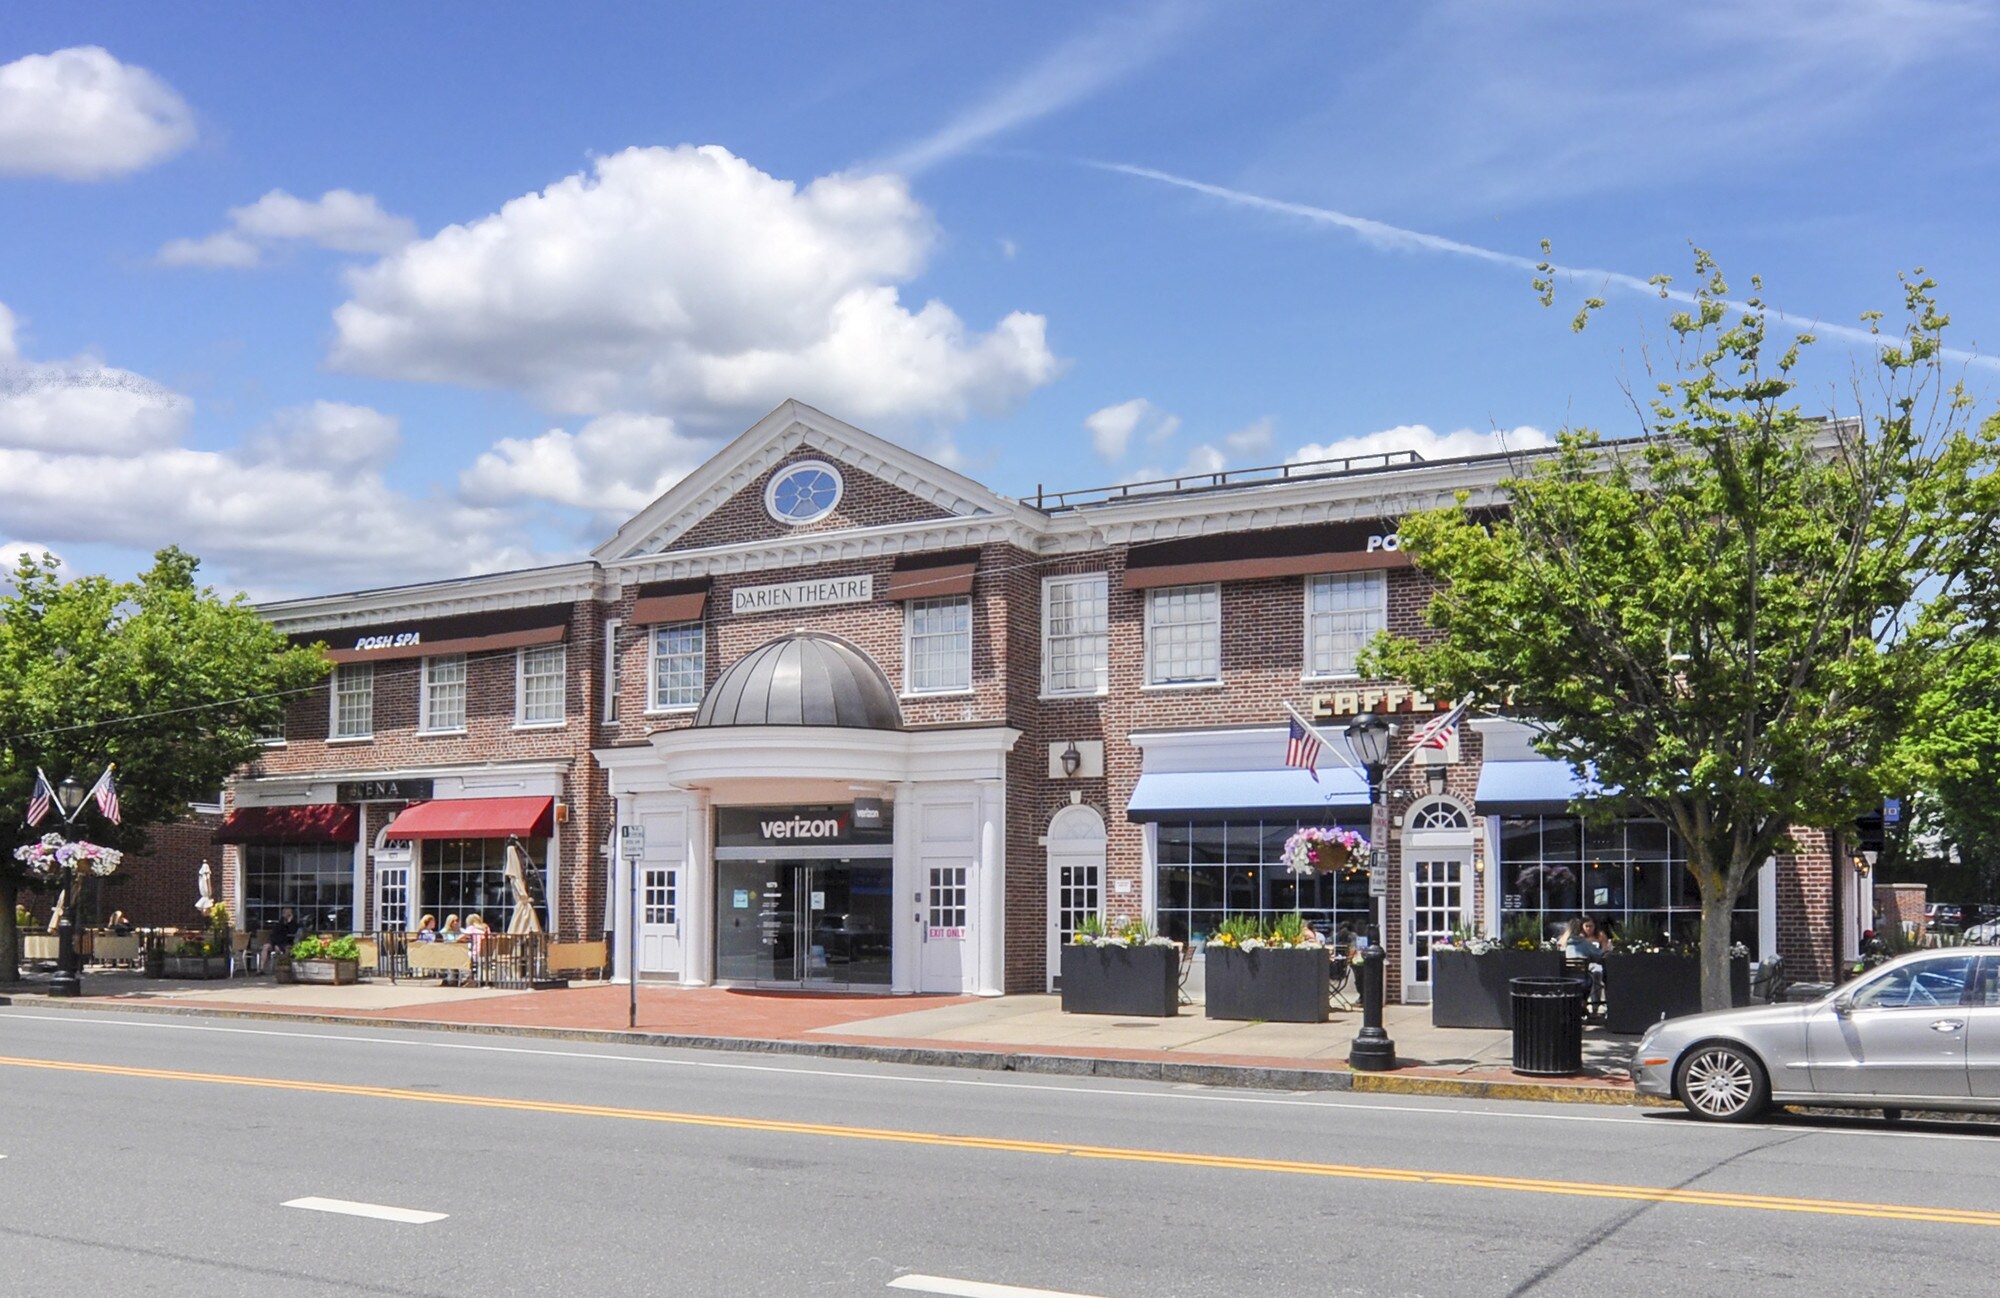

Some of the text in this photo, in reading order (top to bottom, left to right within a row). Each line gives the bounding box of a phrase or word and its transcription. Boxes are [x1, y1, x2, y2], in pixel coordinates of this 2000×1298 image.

[735, 580, 868, 609] DARIEN THEATRE
[355, 632, 420, 651] POSH SPA
[856, 807, 879, 818] verizon
[761, 815, 838, 838] verizon
[929, 928, 966, 938] EXIT ONLY
